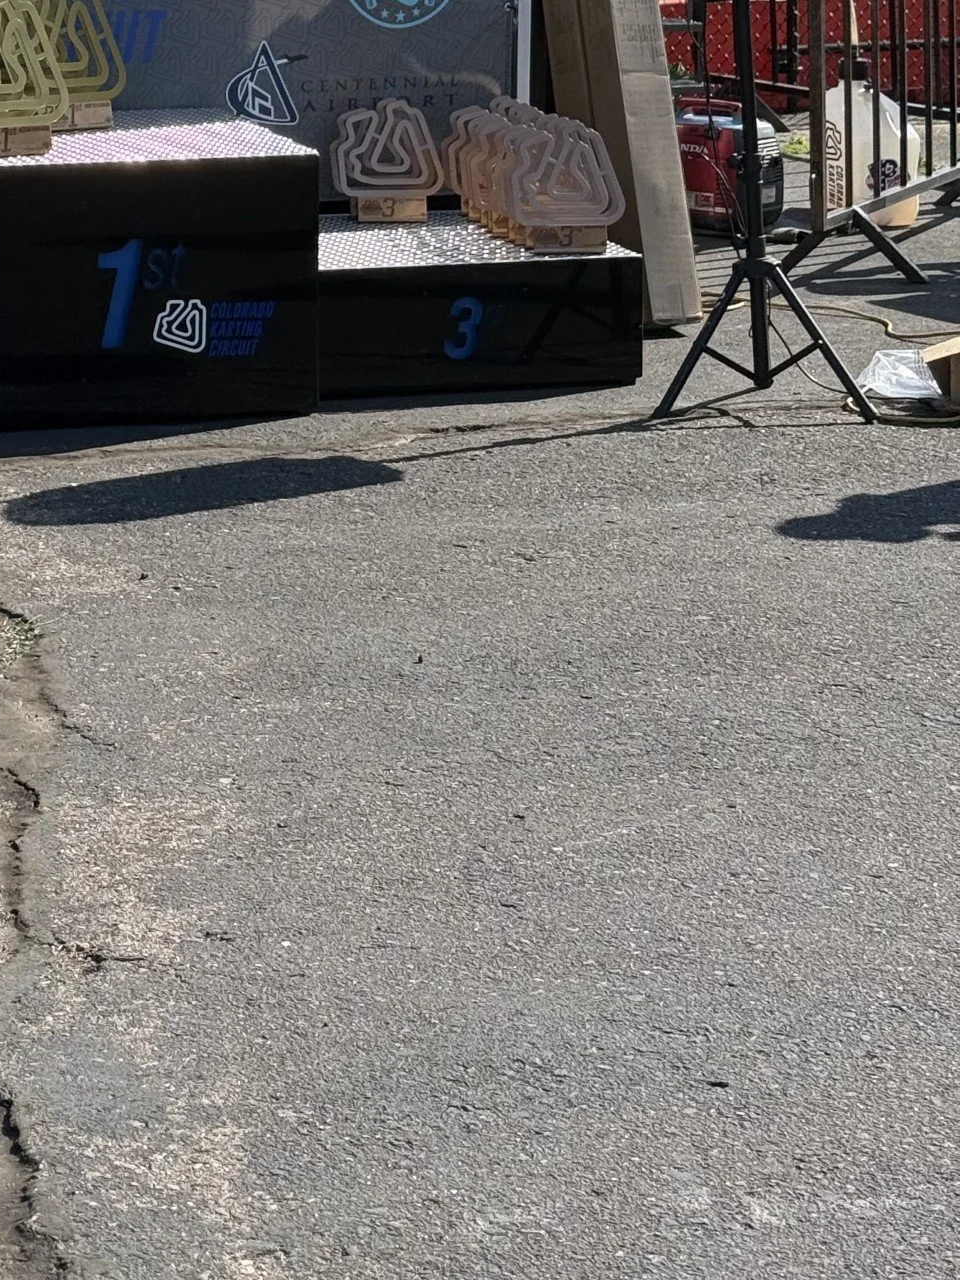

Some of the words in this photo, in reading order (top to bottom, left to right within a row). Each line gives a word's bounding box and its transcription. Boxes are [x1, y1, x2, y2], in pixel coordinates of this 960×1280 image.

[300, 75, 459, 93] CENTENNIAL
[835, 165, 844, 208] COLORAD
[210, 301, 276, 319] COLORADO
[209, 320, 263, 337] KARTING
[208, 339, 259, 357] CIRCUIT
